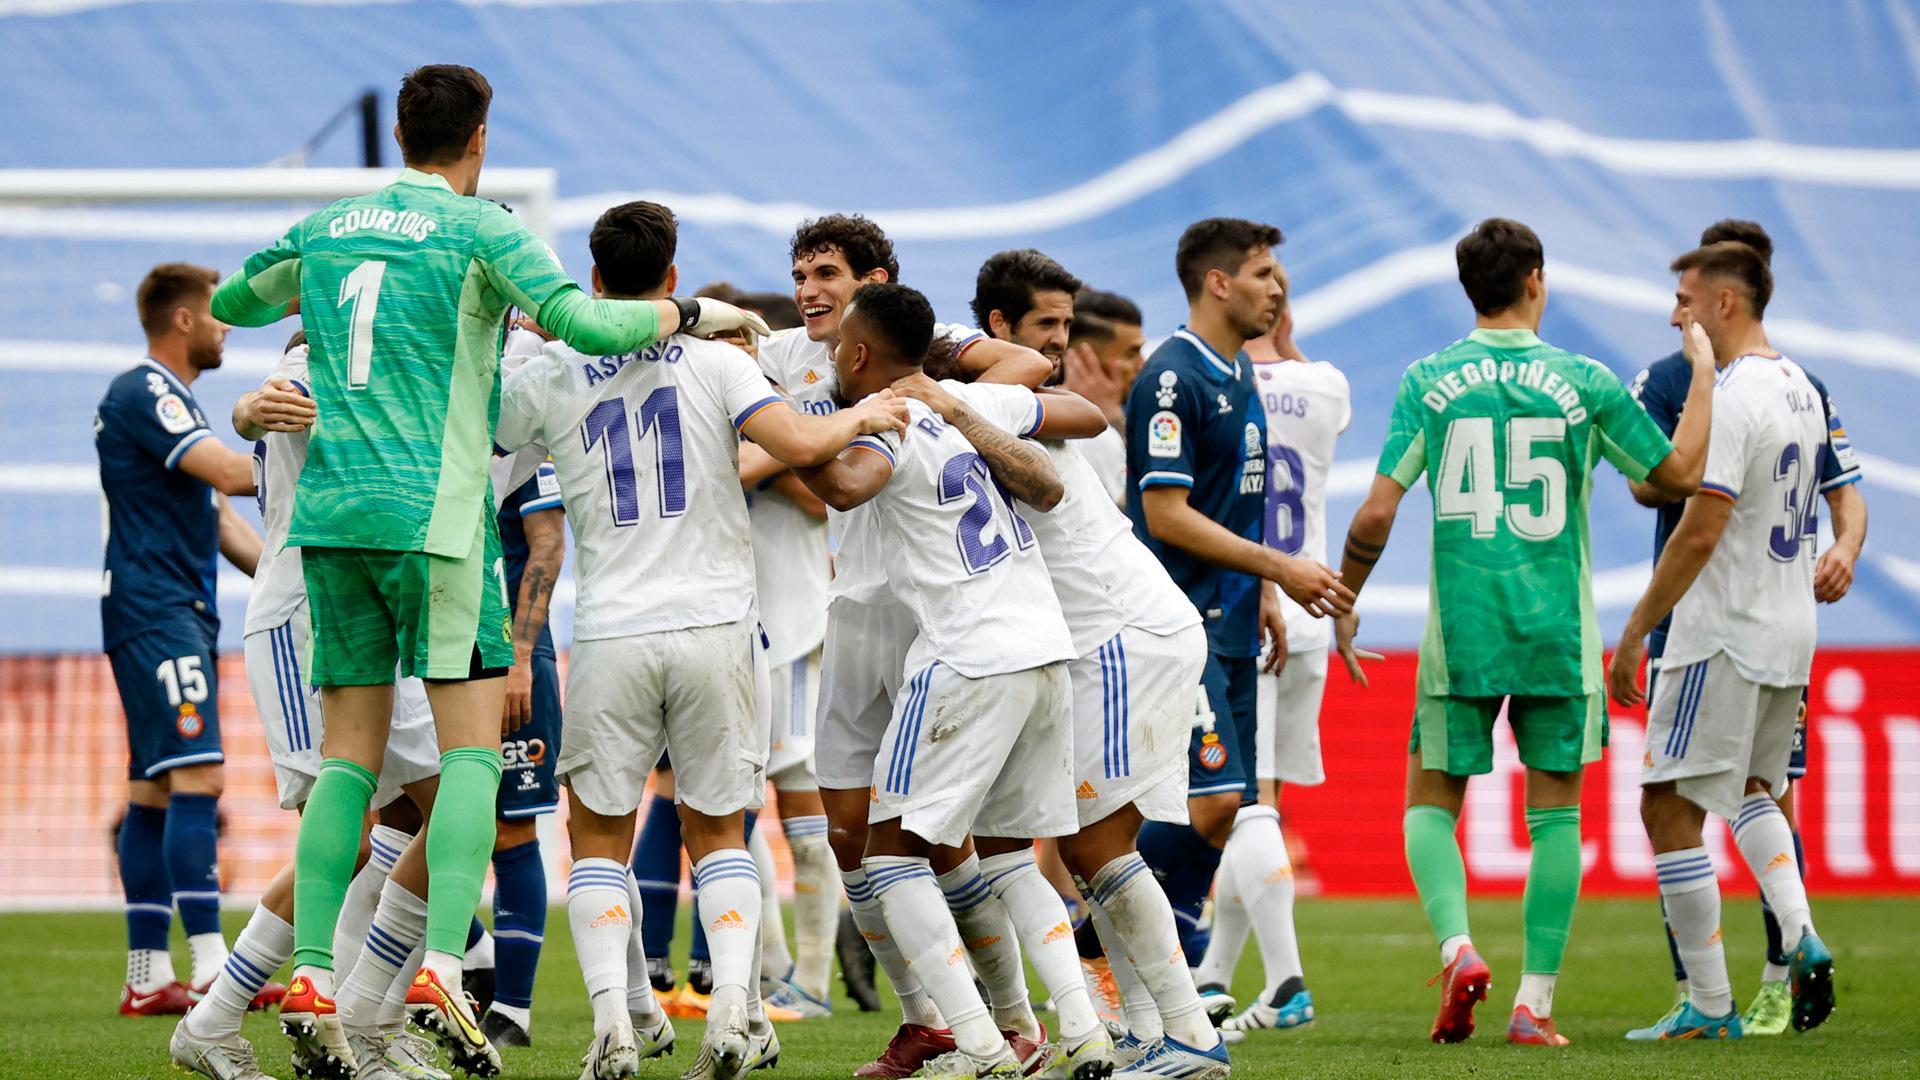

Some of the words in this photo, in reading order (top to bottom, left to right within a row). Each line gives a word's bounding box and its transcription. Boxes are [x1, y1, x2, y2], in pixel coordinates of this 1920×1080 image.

[329, 209, 436, 243] COURTOIS
[337, 260, 387, 391] 1
[580, 385, 687, 528] 11
[1266, 392, 1309, 418] OOS
[1263, 443, 1306, 557] 8
[1435, 416, 1569, 543] 45
[1767, 441, 1827, 565] 34
[493, 557, 509, 609] 1
[156, 655, 209, 705] 15
